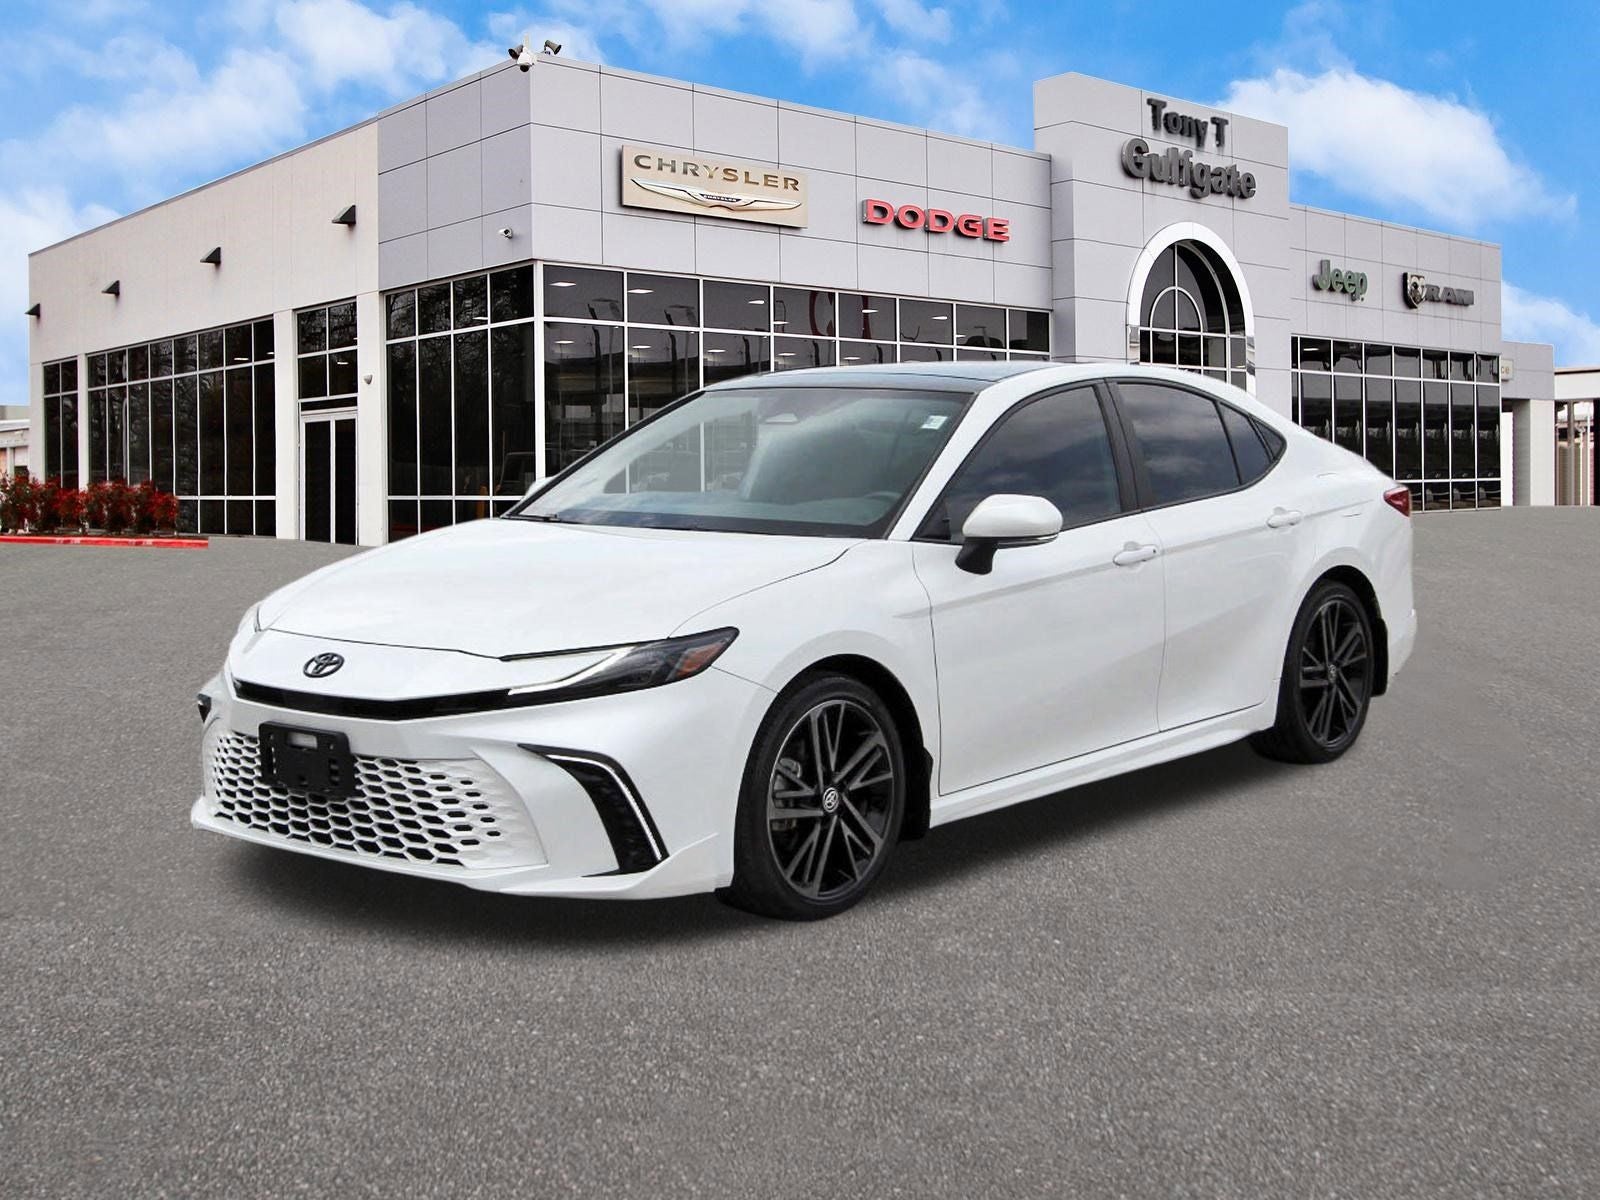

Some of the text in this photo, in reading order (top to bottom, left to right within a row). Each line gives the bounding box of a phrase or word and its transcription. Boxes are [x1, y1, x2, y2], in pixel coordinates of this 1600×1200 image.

[1147, 98, 1229, 147] Tony T
[633, 154, 799, 191] CHRYSLER
[1121, 138, 1256, 199] Gulfgate
[862, 199, 1010, 242] DODGE
[1312, 260, 1367, 301] Jeep
[1425, 284, 1474, 306] RAM
